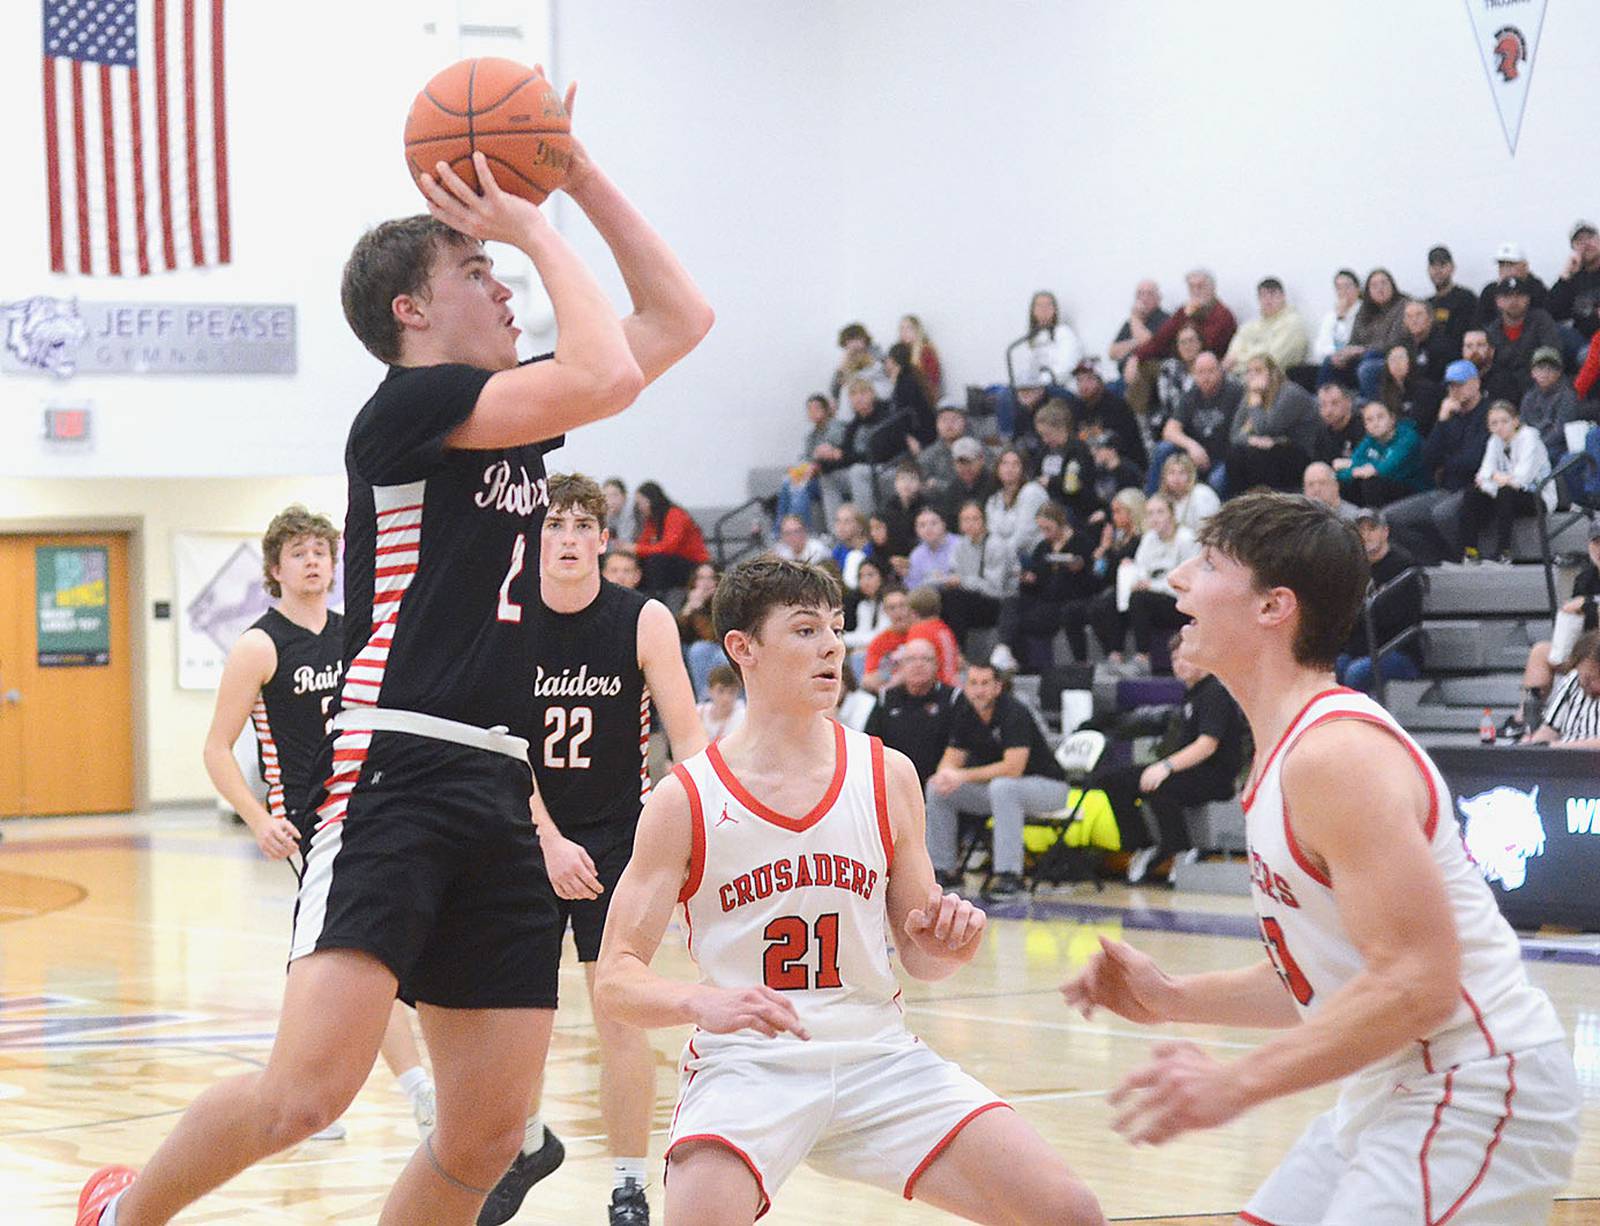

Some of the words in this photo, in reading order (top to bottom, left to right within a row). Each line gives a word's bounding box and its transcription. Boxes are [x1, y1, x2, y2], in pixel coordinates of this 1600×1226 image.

[99, 308, 174, 337] JEFF
[186, 309, 289, 339] PEASE
[293, 660, 343, 695] Raid
[543, 705, 594, 769] 22
[718, 853, 878, 913] CRUSADERS
[762, 912, 844, 991] 21
